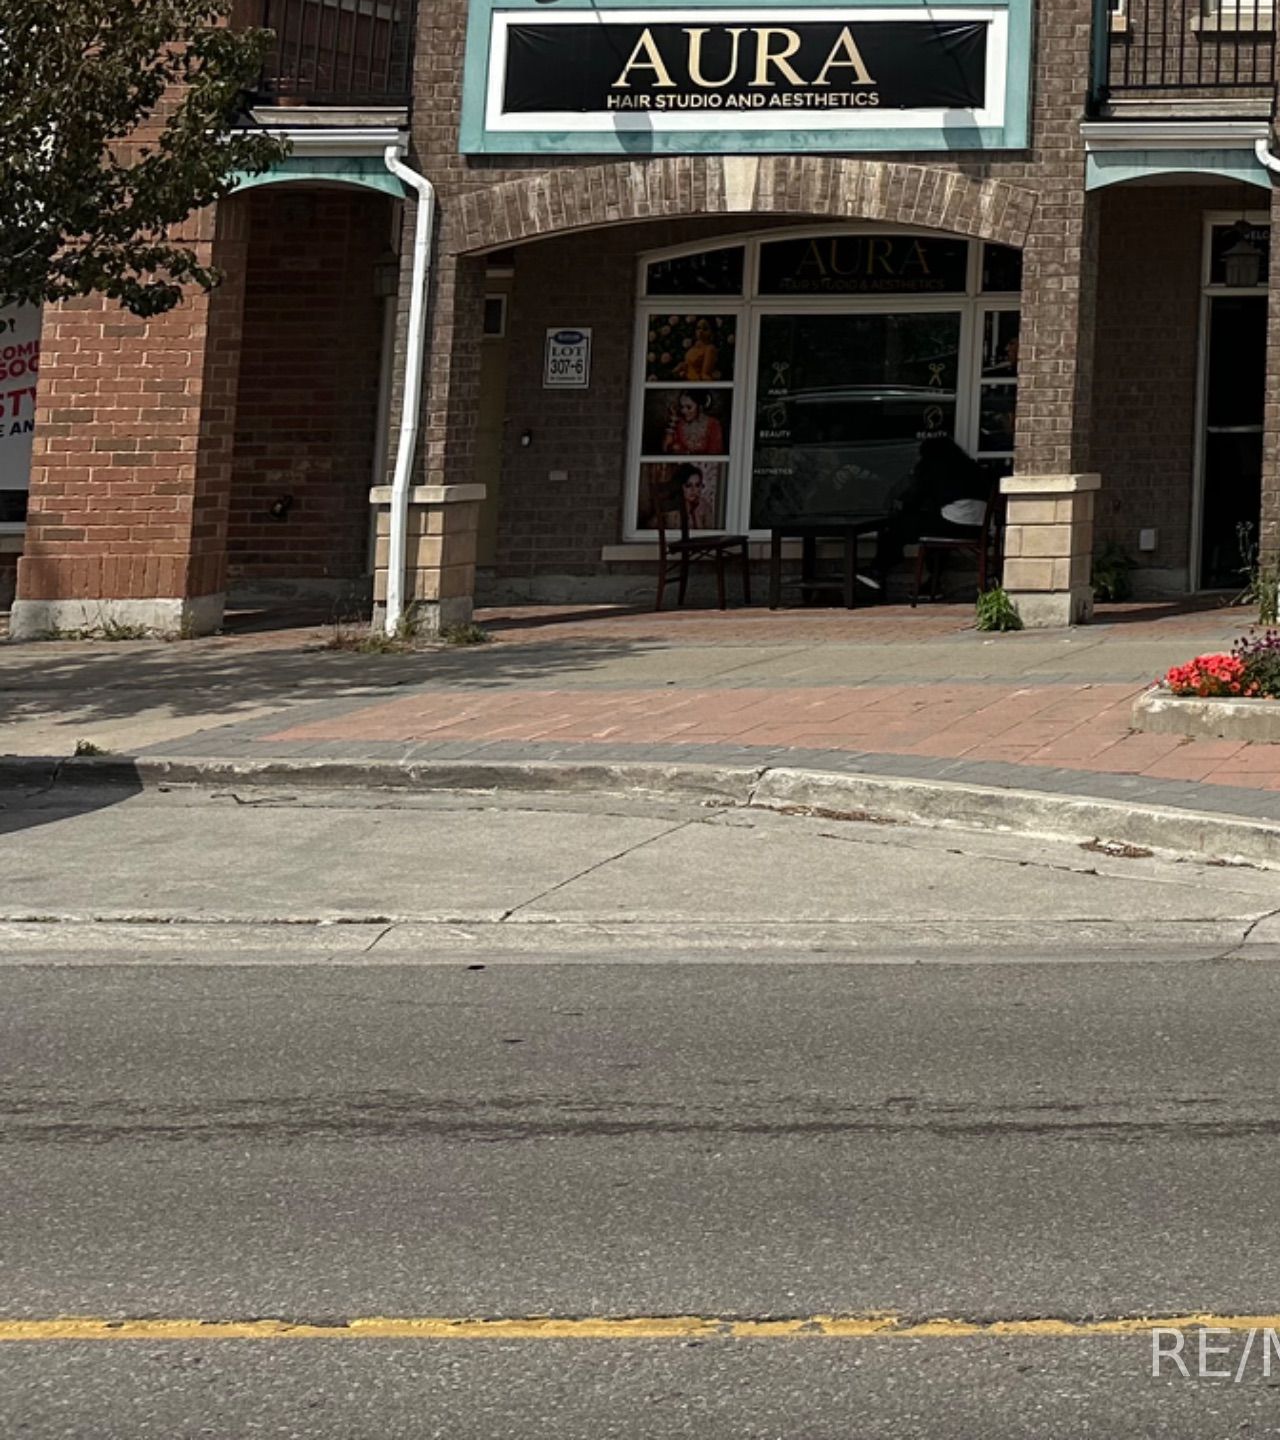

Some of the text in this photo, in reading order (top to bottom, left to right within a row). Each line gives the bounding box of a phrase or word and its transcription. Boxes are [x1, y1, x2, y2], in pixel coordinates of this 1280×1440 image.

[611, 25, 877, 87] AURA
[607, 91, 880, 108] HAIR STUDIO AND AESTHETICS
[795, 238, 931, 276] AURA
[812, 277, 857, 290] STUDIO
[870, 277, 945, 290] AESTHETICS
[552, 346, 585, 357] LOT
[759, 429, 792, 438] BEAUTY
[915, 430, 948, 439] BEAUTY
